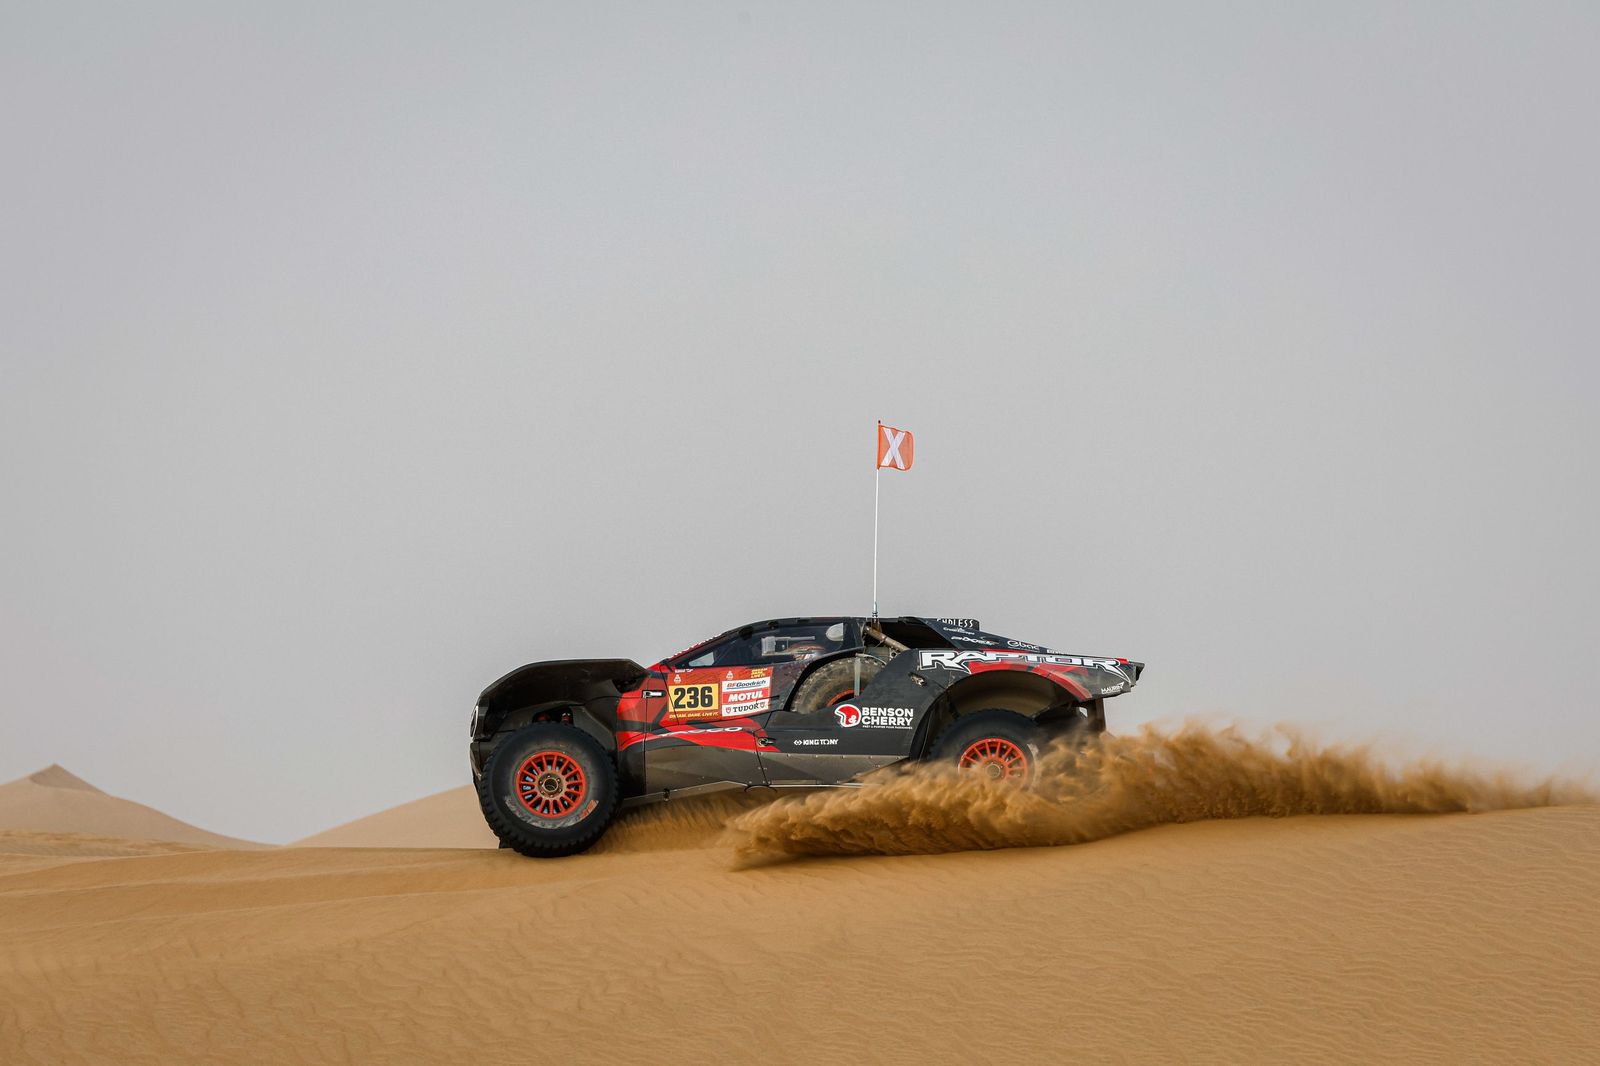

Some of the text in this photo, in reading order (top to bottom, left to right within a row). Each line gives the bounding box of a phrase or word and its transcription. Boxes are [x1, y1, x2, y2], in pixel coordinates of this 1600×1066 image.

[919, 650, 1131, 685] RAPTOR
[673, 686, 713, 709] 236
[728, 690, 764, 703] MOTUL
[732, 703, 759, 713] TUDOR
[862, 706, 914, 717] BENSON
[861, 717, 914, 726] CHERRY
